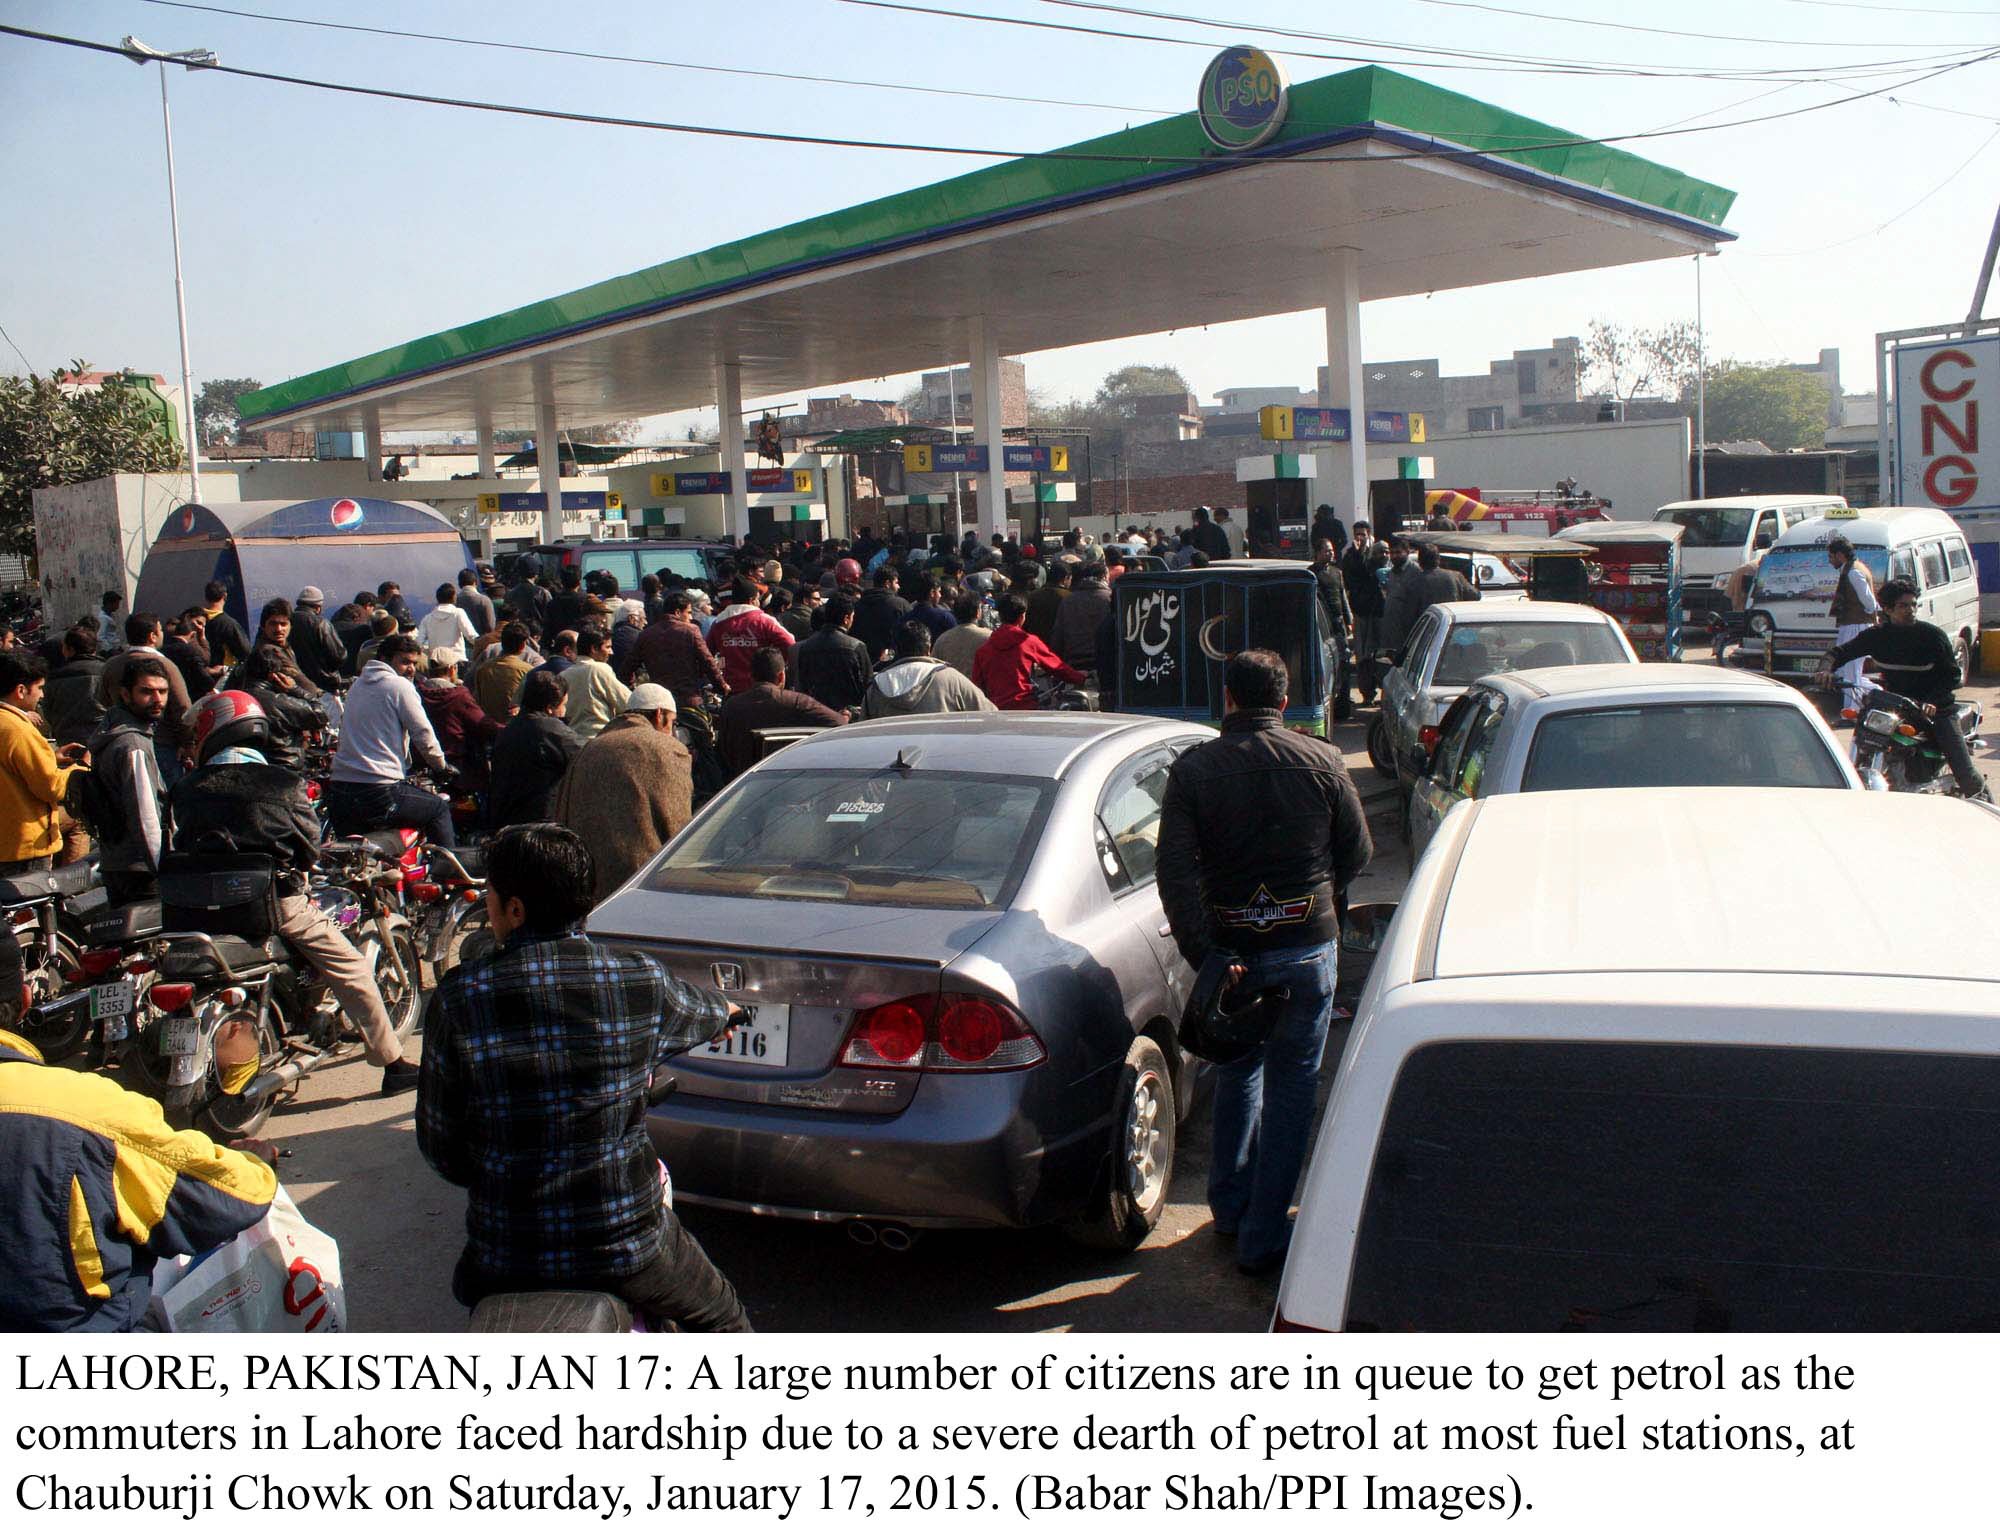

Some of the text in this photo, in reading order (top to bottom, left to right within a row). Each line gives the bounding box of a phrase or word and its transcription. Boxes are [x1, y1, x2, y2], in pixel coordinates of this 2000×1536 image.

[1221, 69, 1273, 112] PSO
[1280, 413, 1287, 432] 1
[1414, 419, 1419, 434] 3
[1920, 348, 1979, 507] CNG
[919, 451, 925, 466] 5
[940, 453, 966, 464] PREMIER
[1056, 452, 1062, 465] 7
[661, 479, 669, 491] 9
[796, 476, 807, 488] 11
[485, 498, 495, 509] 13
[608, 494, 619, 506] 15
[836, 802, 886, 813] PISCES
[1243, 905, 1286, 920] TOP GUN
[99, 985, 120, 999] LEL
[99, 999, 125, 1014] 3353
